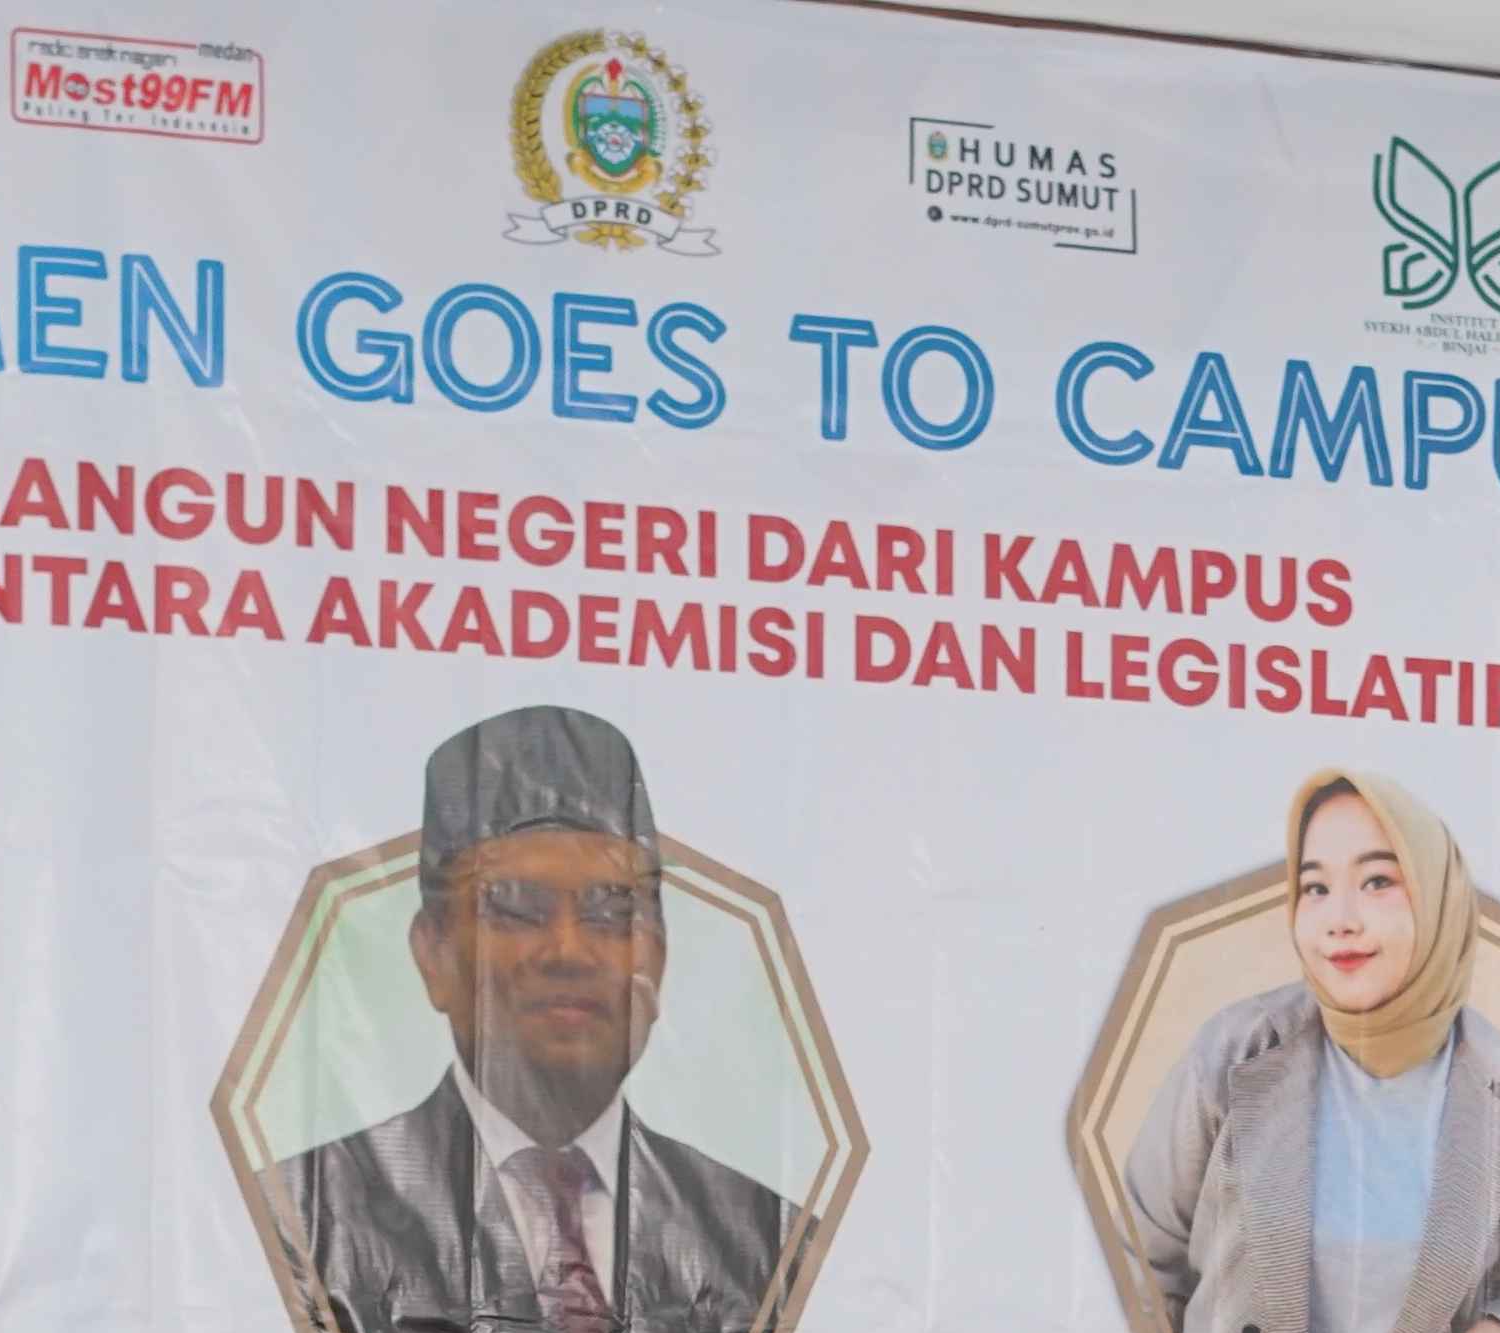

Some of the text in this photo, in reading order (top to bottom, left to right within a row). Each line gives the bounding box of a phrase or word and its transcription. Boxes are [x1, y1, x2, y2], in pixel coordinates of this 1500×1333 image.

[24, 61, 254, 119] Most99FM
[959, 137, 1117, 179] HUMAS
[571, 201, 652, 225] DPRD
[926, 169, 1120, 213] DPRD SUMUT
[1430, 313, 1499, 330] INSTITUT
[294, 270, 728, 431] GOES
[788, 312, 996, 451] TO
[387, 485, 717, 577] NEGERI
[748, 514, 954, 597] DARI
[985, 534, 1353, 627] KAMPUS
[308, 577, 825, 679] AKADEMISI
[855, 615, 1036, 693] DAN
